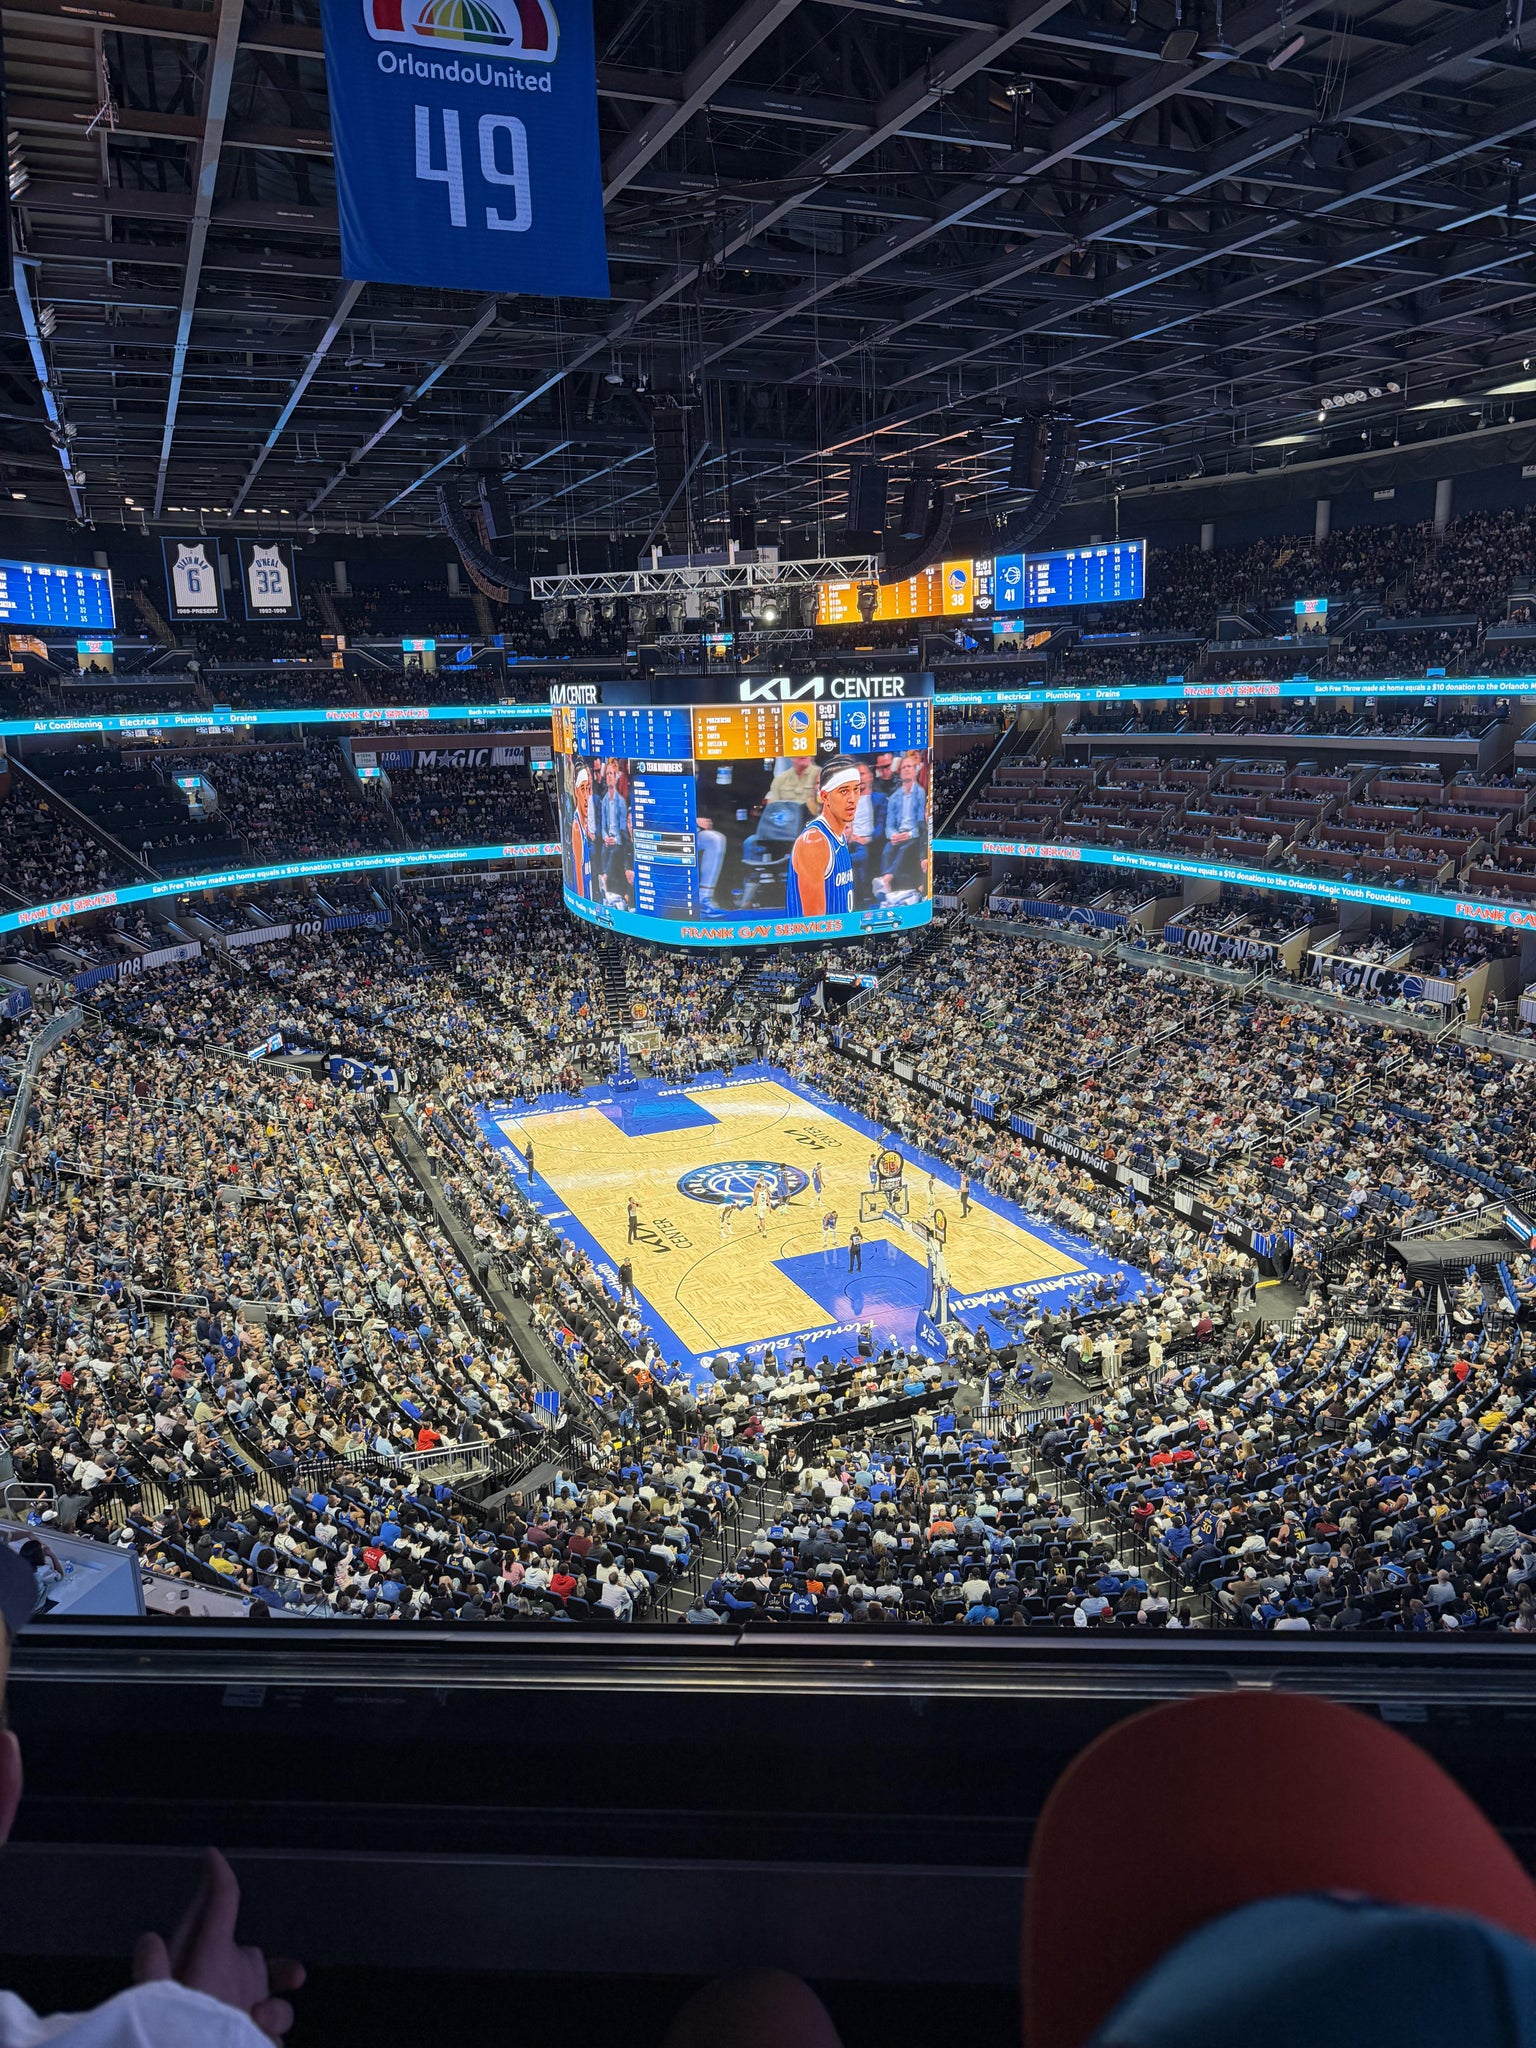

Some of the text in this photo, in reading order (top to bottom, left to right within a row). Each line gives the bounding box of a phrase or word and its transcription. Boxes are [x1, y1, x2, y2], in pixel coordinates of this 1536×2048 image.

[377, 50, 552, 93] OrlandoUnited
[415, 104, 533, 232] 49
[256, 558, 279, 568] O'NEAL
[976, 560, 992, 570] 9:01
[187, 568, 202, 594] 6
[256, 570, 283, 594] 32
[952, 594, 964, 606] 38
[1004, 588, 1016, 602] 41
[566, 685, 598, 704] CENTER
[740, 677, 904, 702] KIA CENTER
[935, 689, 1120, 703] Conditioning Electrical Plumbing Drains
[1405, 684, 1426, 693] equals
[1432, 684, 1444, 692] $10
[1446, 684, 1476, 692] donation
[1486, 682, 1499, 690] the
[1500, 682, 1530, 690] Orlando
[818, 704, 836, 714] 9:01
[34, 714, 258, 730] Air Conditioning Electrical Plumbing Drains
[792, 738, 808, 750] 38
[850, 734, 861, 748] 41
[543, 845, 562, 855] GA
[152, 885, 168, 894] Each
[169, 883, 184, 893] Free
[185, 880, 207, 890] Throw
[208, 876, 226, 886] made
[236, 872, 256, 882] home
[256, 869, 280, 880] equals
[286, 866, 300, 875] $10
[300, 862, 332, 872] donation
[342, 860, 354, 868] the
[355, 857, 384, 867] Orlando
[384, 856, 406, 866] Magic
[406, 853, 428, 862] Youth
[428, 851, 468, 861] Foundation
[1113, 854, 1126, 862] Each
[1126, 856, 1138, 864] Free
[1139, 858, 1156, 866] Throw
[1157, 861, 1173, 869] made
[1180, 864, 1197, 872] home
[1198, 866, 1218, 876] equals
[1224, 870, 1236, 878] $10
[1236, 872, 1265, 884] donation
[1266, 876, 1274, 886] to
[1274, 878, 1287, 888] the
[1288, 879, 1318, 892] Orlando
[1318, 884, 1340, 896] Magic
[1342, 886, 1364, 898] Youth
[1365, 890, 1412, 906] Foundation
[1456, 903, 1506, 922] FRANK
[294, 920, 322, 937] 109
[681, 920, 843, 939] FRANK GAY SERVICES
[116, 957, 141, 978] 108
[492, 1102, 584, 1120] Florida Blue
[803, 1126, 842, 1148] CENTER
[652, 1218, 693, 1249] CENTER
[744, 1336, 794, 1354] Blue
